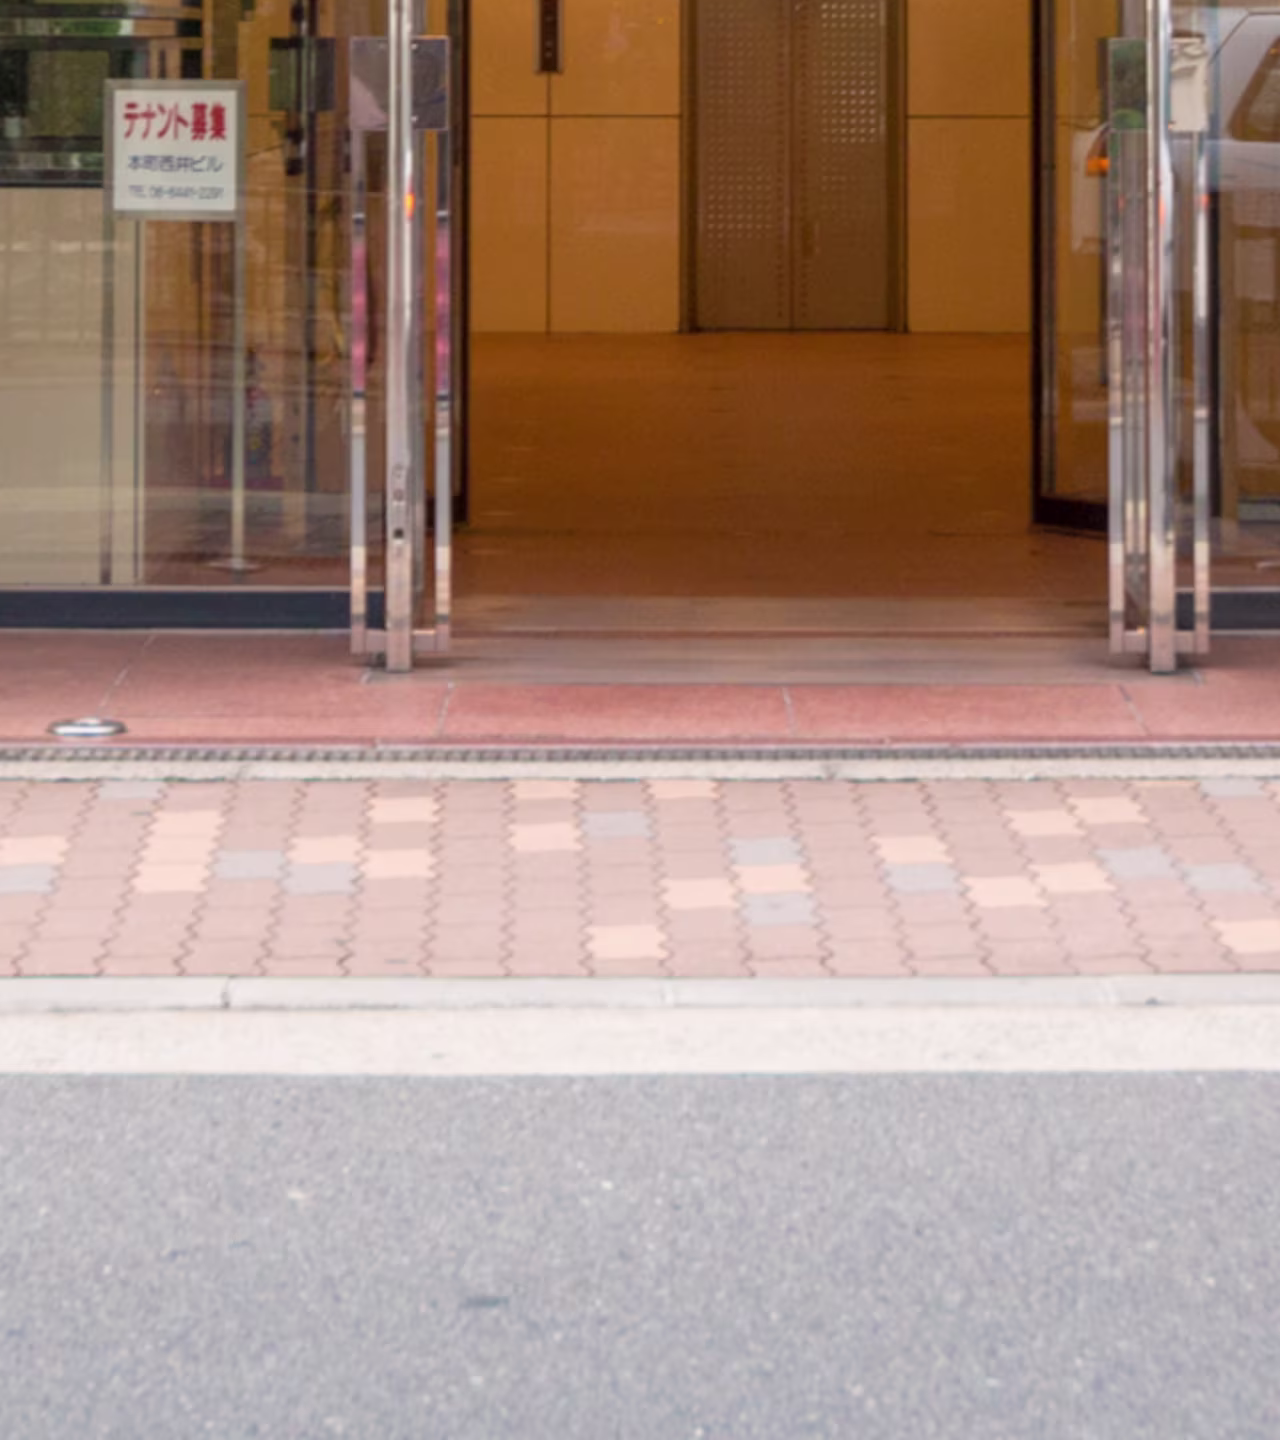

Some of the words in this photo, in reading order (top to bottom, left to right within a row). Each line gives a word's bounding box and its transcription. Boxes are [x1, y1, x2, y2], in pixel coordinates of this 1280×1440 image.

[123, 102, 227, 141] テナント募集
